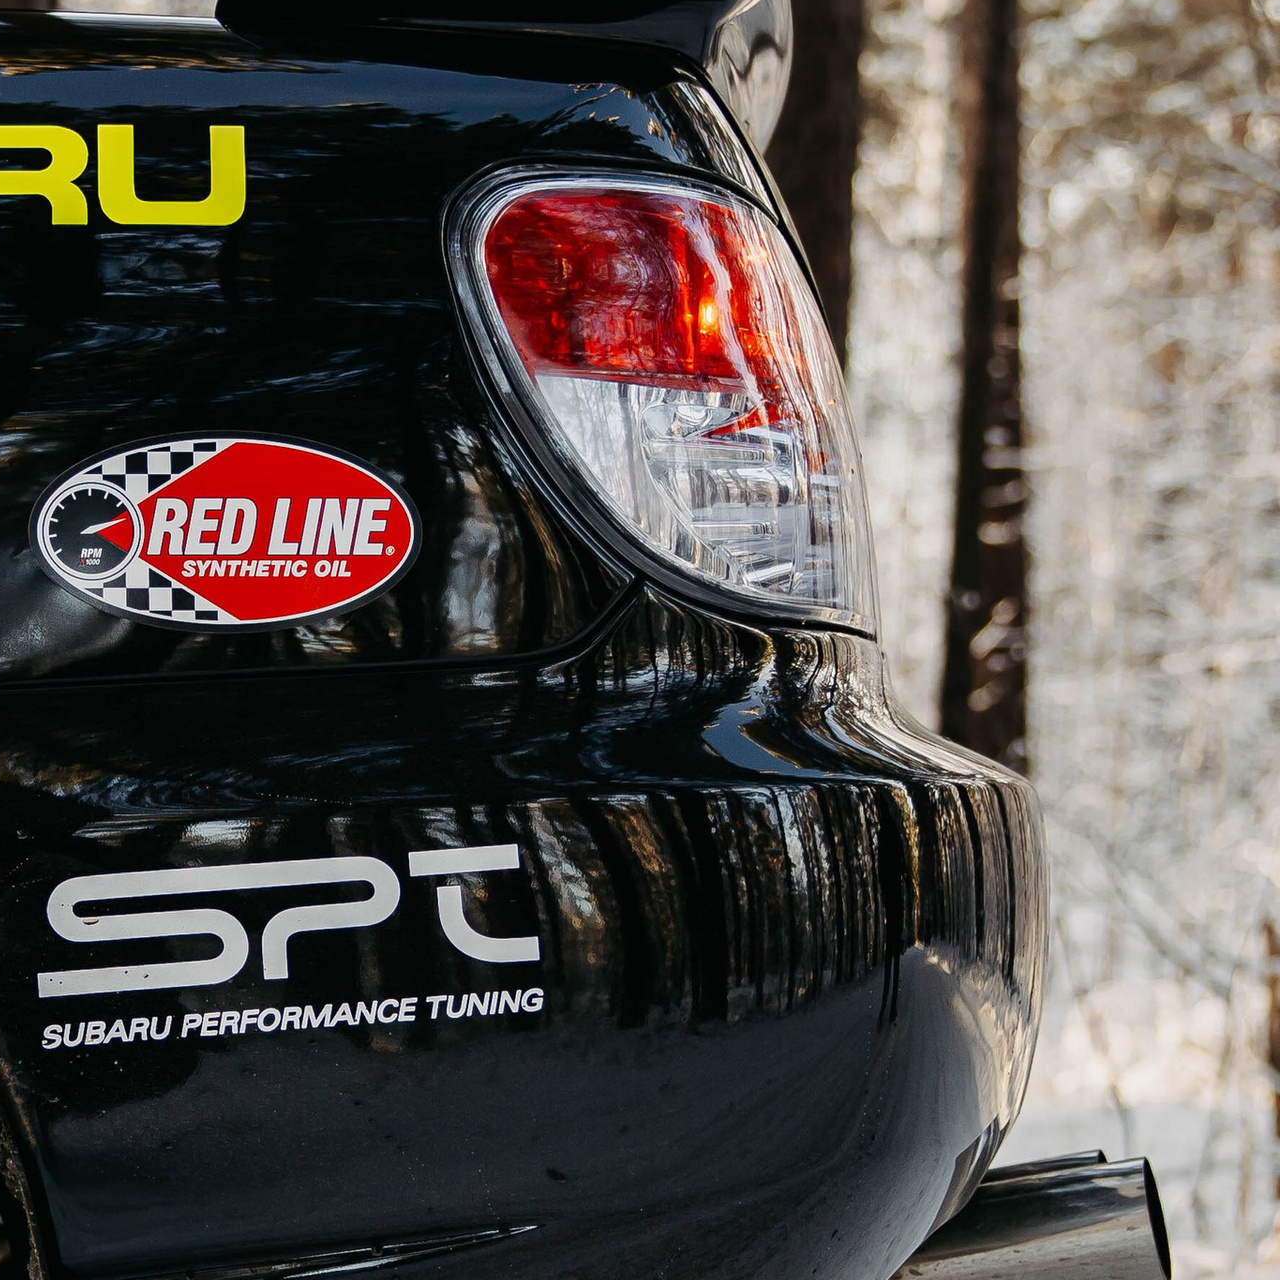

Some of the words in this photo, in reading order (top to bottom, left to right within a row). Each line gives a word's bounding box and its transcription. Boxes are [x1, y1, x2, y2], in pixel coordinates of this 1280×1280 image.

[146, 497, 259, 556] RED
[81, 548, 103, 558] RPM
[181, 559, 308, 578] SYNTHETIC
[314, 559, 352, 578] OIL
[42, 1016, 173, 1049] SUBARU
[181, 996, 418, 1037] PERFORMANCE
[425, 987, 545, 1019] TUNING
